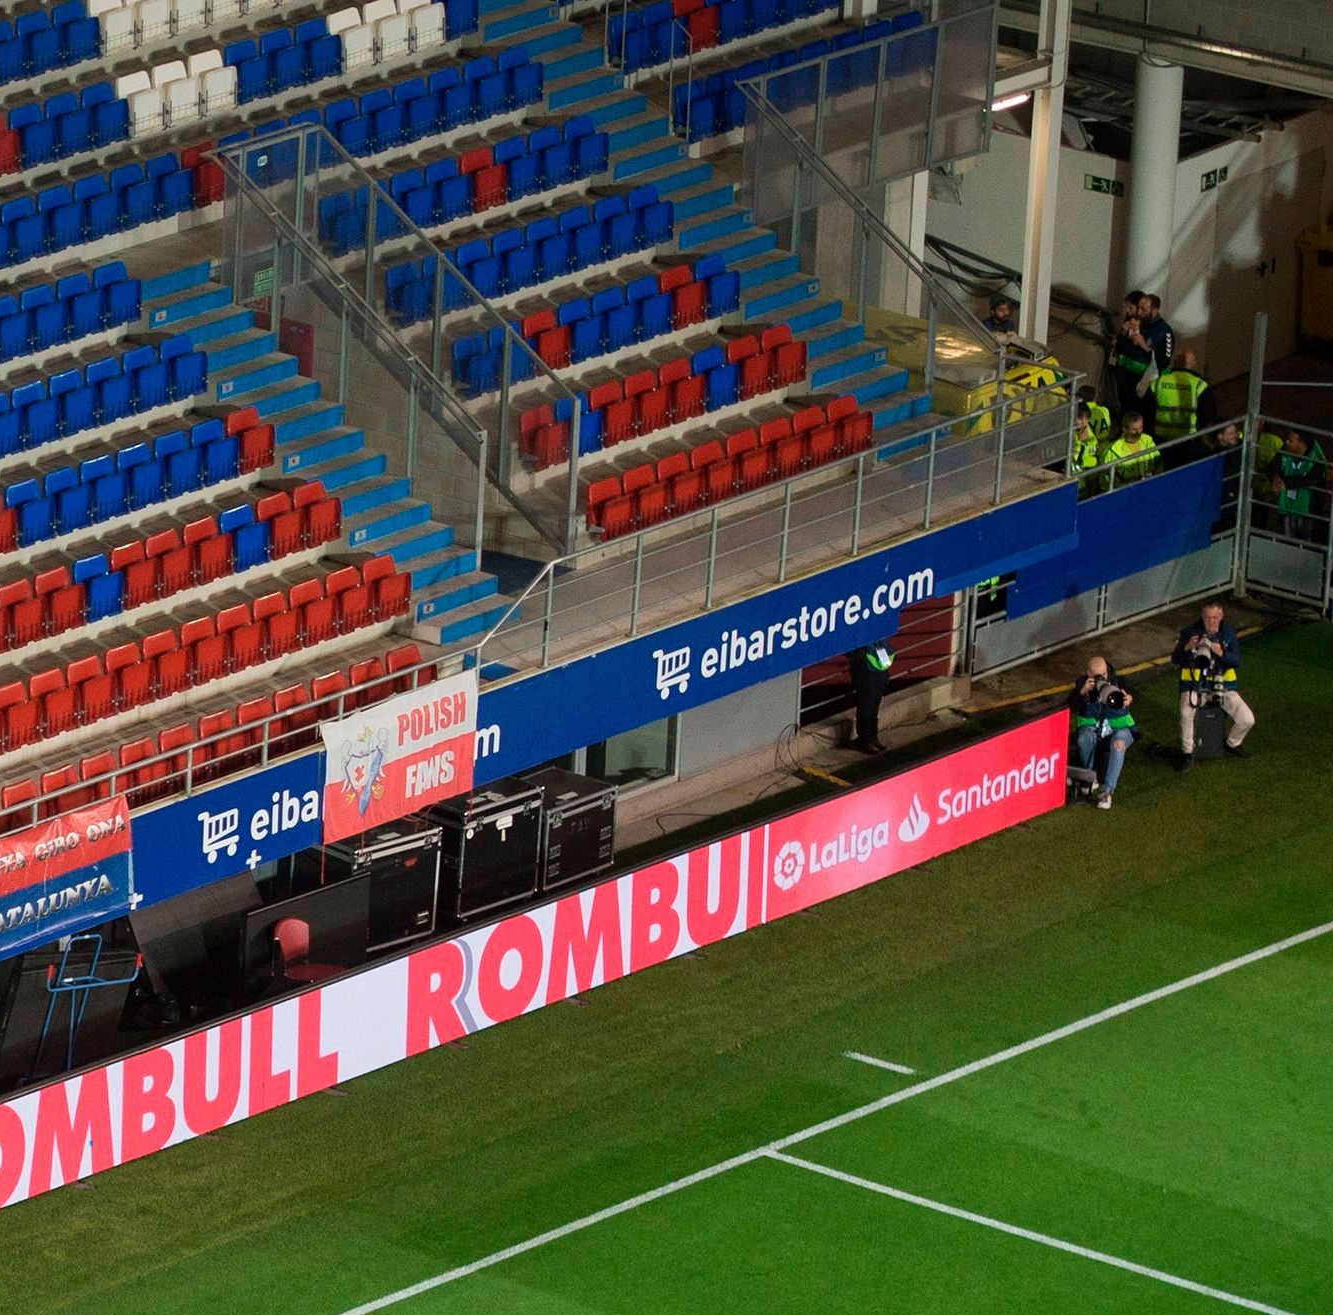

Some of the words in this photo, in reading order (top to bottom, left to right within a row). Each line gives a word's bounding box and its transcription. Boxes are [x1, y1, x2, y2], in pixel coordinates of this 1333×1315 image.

[700, 567, 934, 679] eibarstore.com
[397, 691, 467, 747] POLISH
[405, 751, 455, 799] FANS
[85, 814, 126, 842] ONA
[808, 819, 890, 875] LaLiga
[936, 752, 1061, 825] Santander
